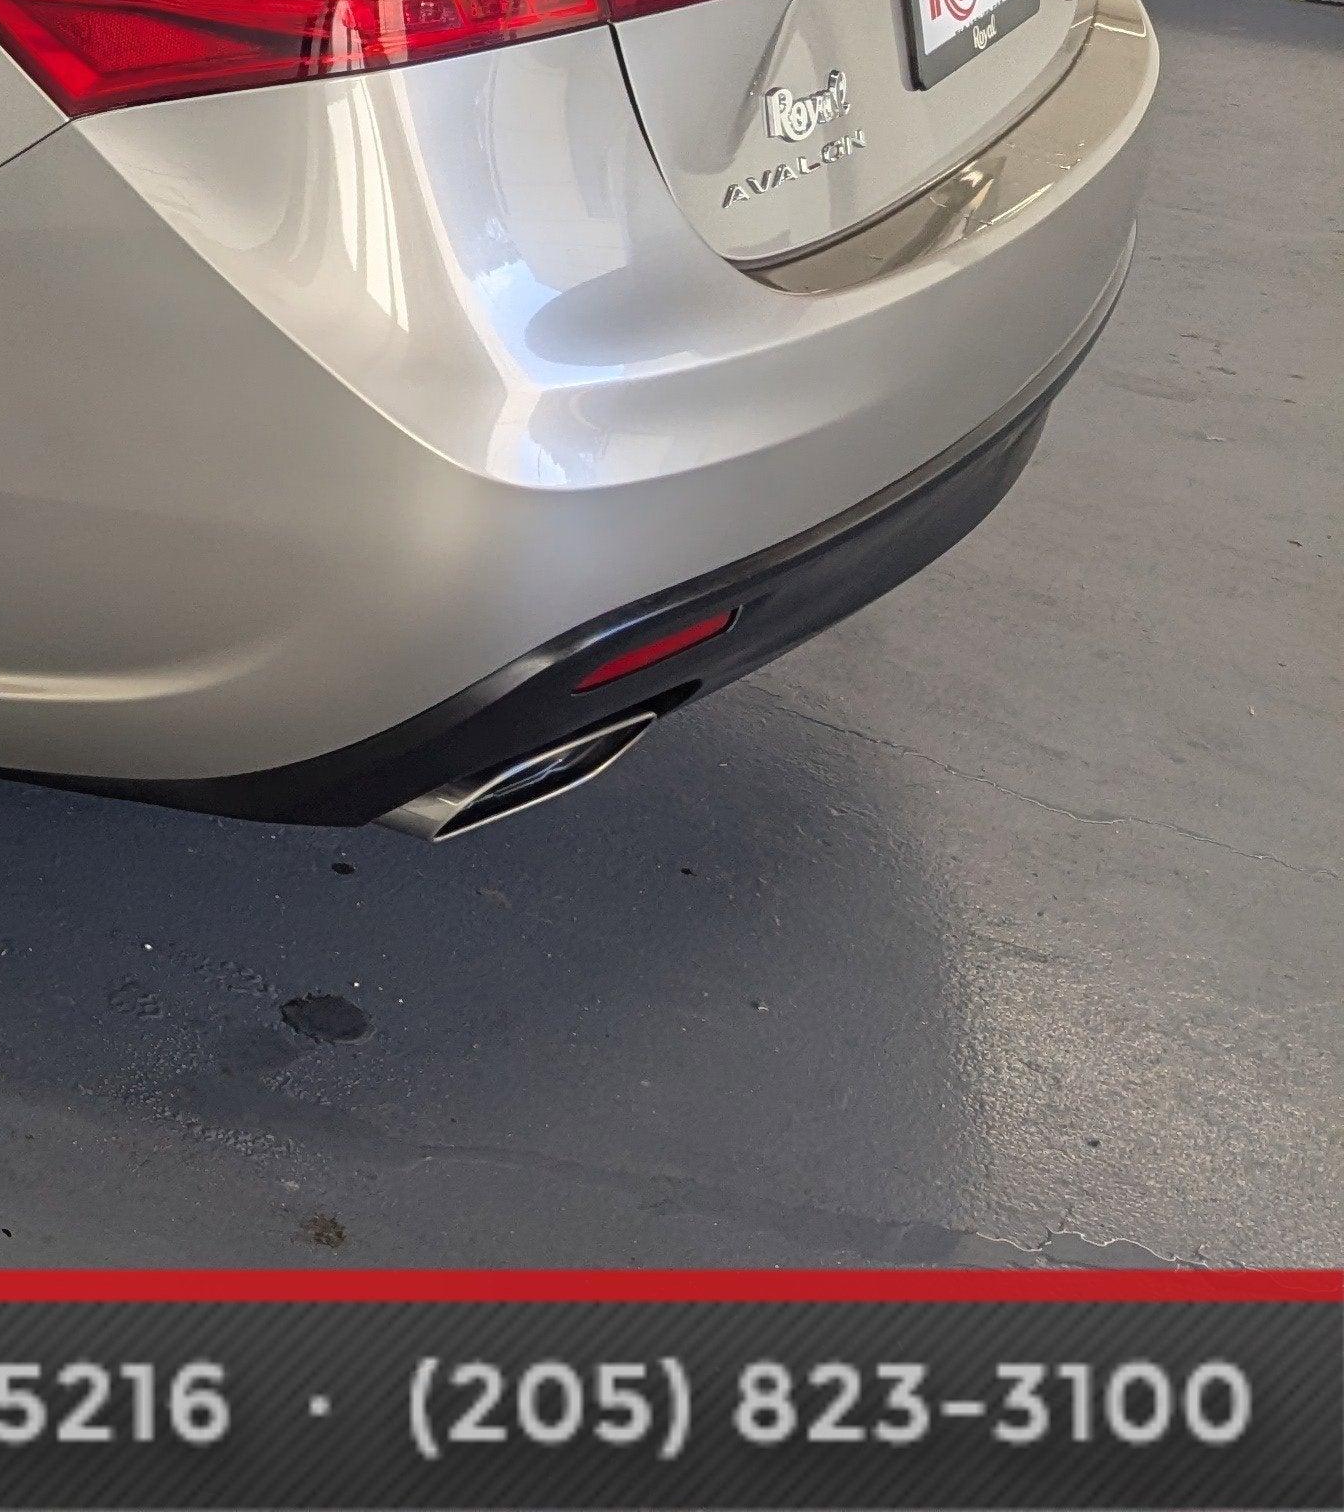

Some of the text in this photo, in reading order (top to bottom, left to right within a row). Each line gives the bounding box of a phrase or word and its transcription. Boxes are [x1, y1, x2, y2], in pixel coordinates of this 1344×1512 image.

[972, 13, 998, 50] Royal
[764, 69, 851, 143] Royal
[722, 128, 867, 209] AVALON
